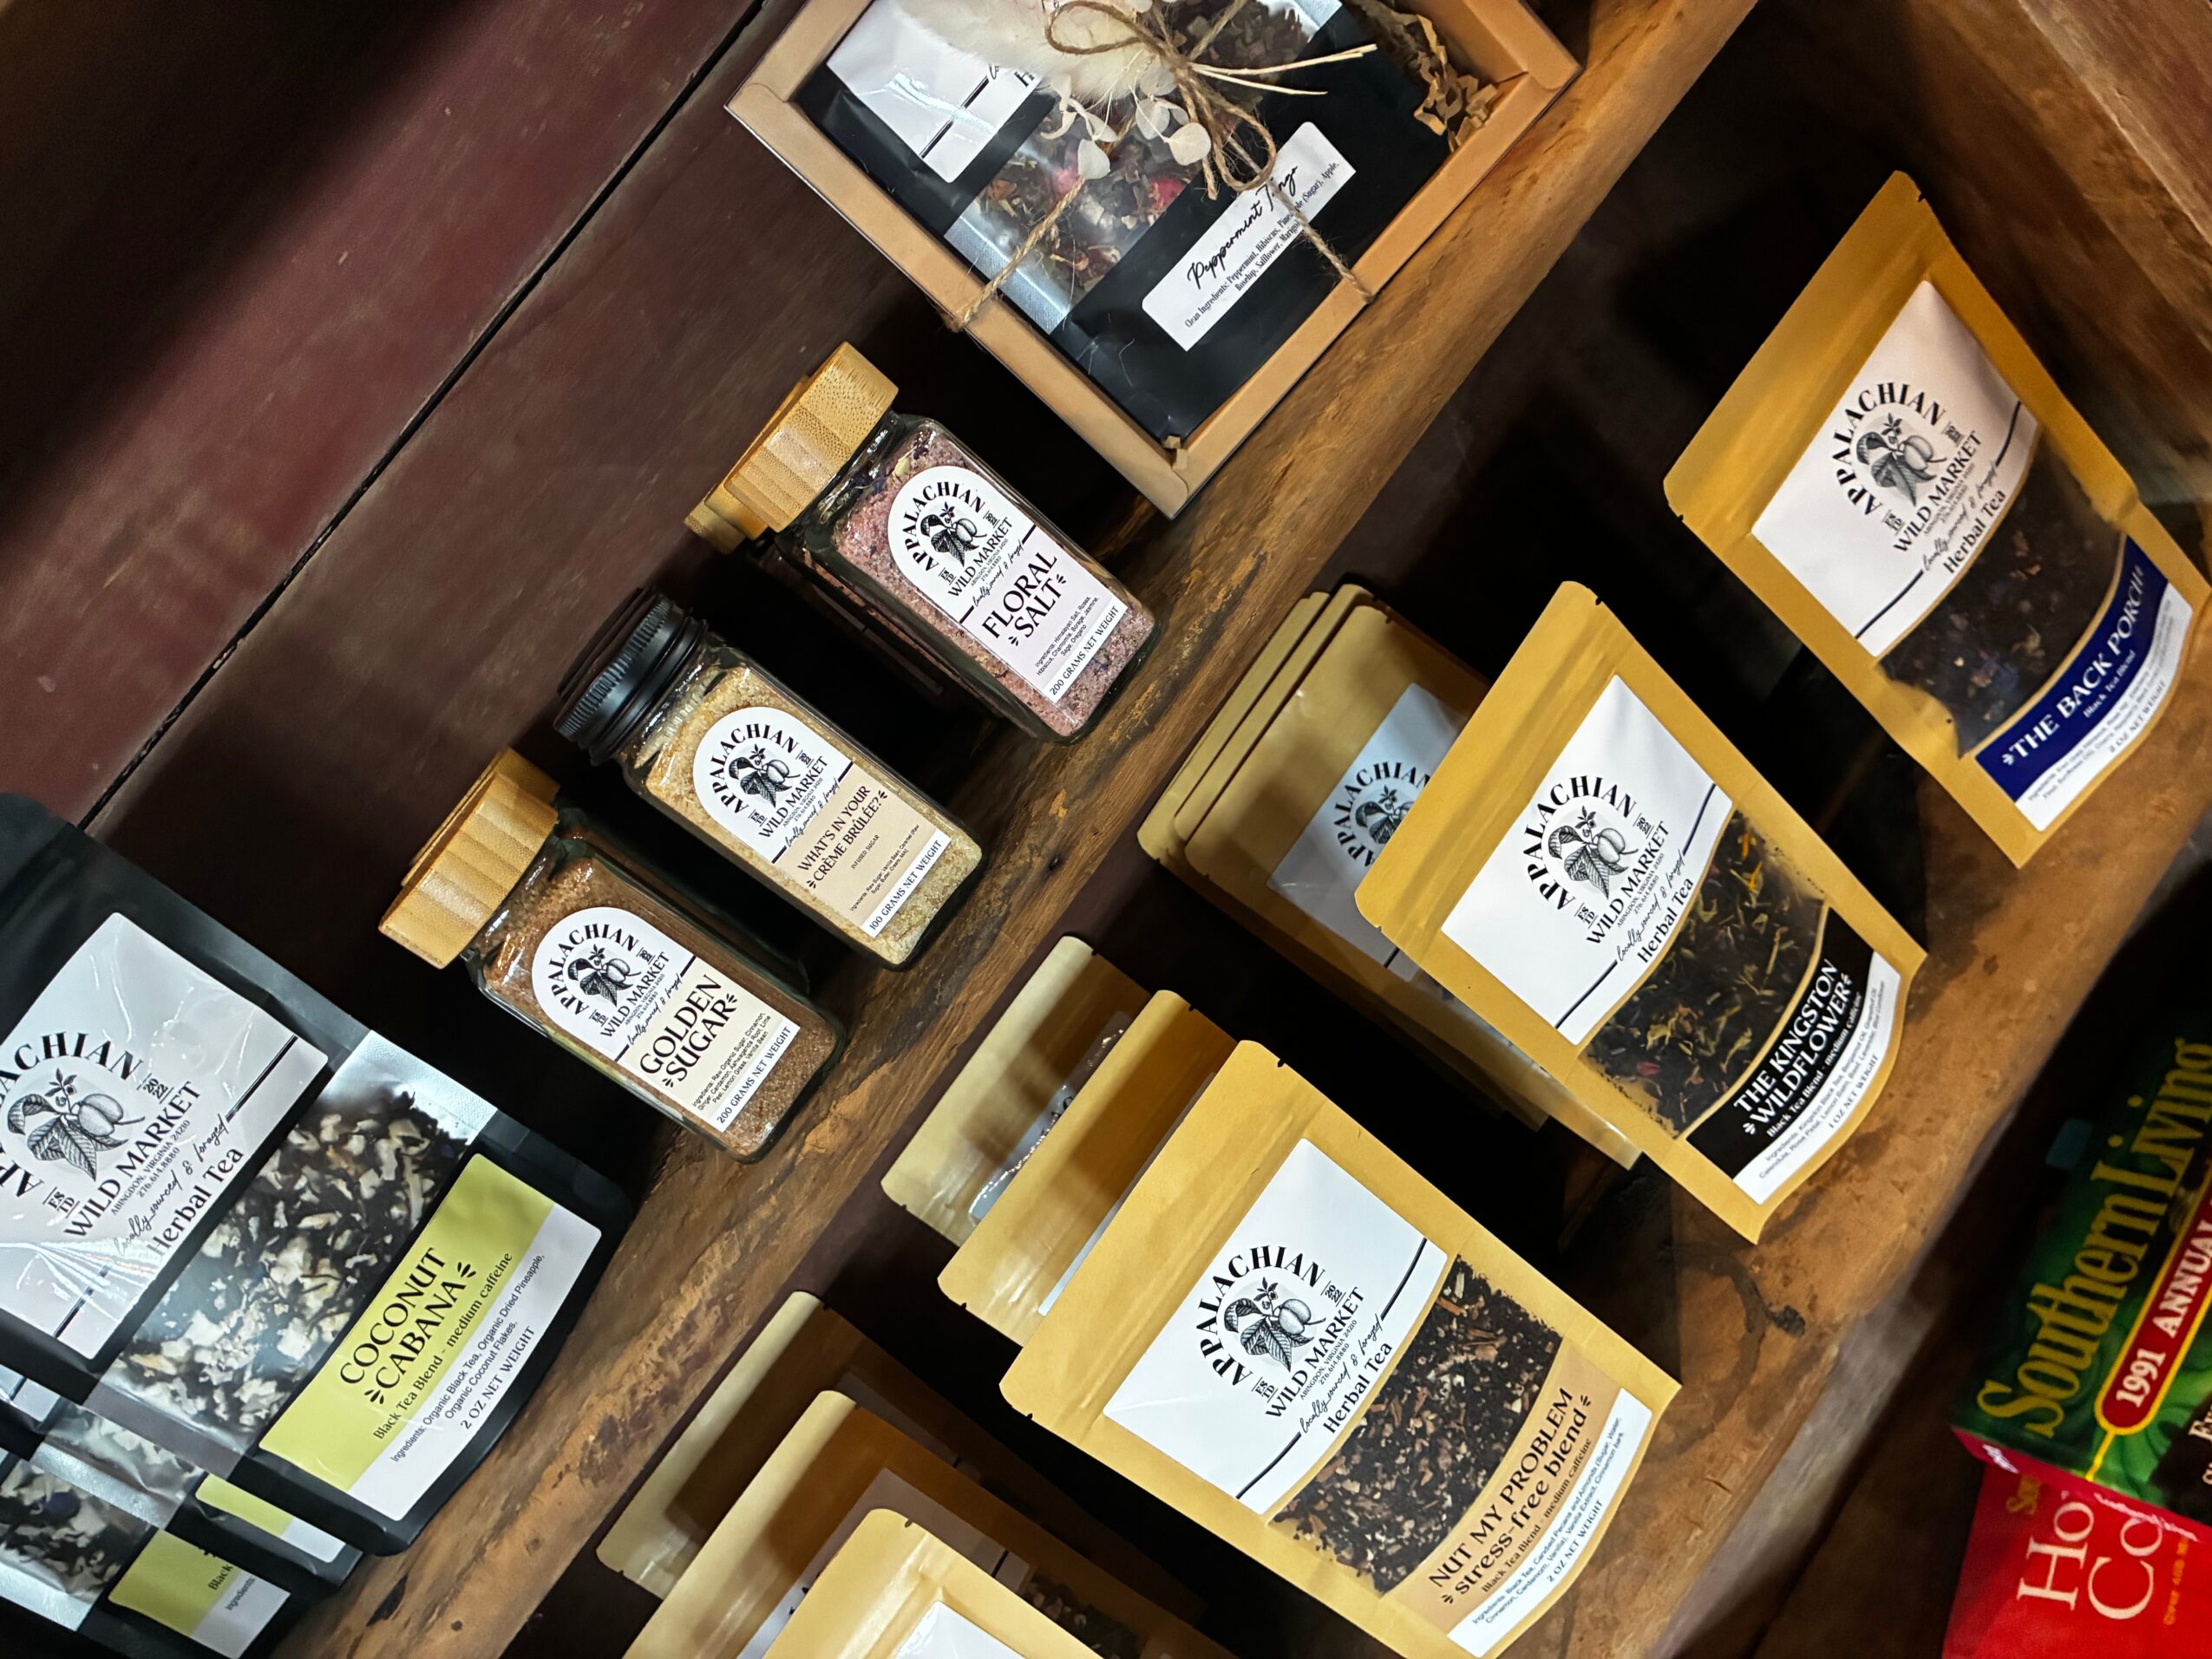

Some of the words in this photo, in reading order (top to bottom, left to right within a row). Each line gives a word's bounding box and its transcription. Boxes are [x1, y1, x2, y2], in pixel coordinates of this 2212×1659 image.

[1187, 199, 1263, 291] Peppermint
[1254, 166, 1299, 212] Tngo
[1254, 242, 1283, 269] Safflower,
[1279, 219, 1305, 242] Marigol
[1184, 312, 1201, 328] Clean
[1197, 281, 1230, 315] Ingredients:
[1226, 251, 1260, 284] Peppermint,
[1255, 228, 1281, 252] Hibiscus,
[1832, 382, 1946, 515] APPALACHIAN
[1893, 506, 1932, 552] WILD
[1927, 430, 1981, 506] MARKET
[902, 481, 985, 572] APPALACHIAN
[947, 565, 976, 597] WILD
[972, 516, 1012, 568] MARKET
[1942, 517, 1986, 574] Herbal
[1980, 490, 2006, 518] Tea
[981, 552, 1057, 639] FLORAL
[1014, 578, 1062, 638] SALT
[1049, 679, 1064, 696] 200
[1062, 650, 1086, 679] GRAMS
[1083, 635, 1097, 653] NET
[1095, 605, 1119, 636] WEIGHT
[2008, 714, 2059, 757] THE
[2056, 653, 2112, 718] BACK
[2106, 572, 2143, 656] PORCH
[2083, 694, 2107, 718] Black
[709, 723, 799, 813] APPALACHIAN
[758, 807, 789, 838] WILD
[785, 755, 828, 808] MARKET
[831, 816, 847, 833] IN
[841, 786, 871, 817] YOUR
[813, 842, 847, 881] CRÈME
[841, 796, 882, 846] BRÛLÉE?
[850, 850, 867, 870] INFUSED
[865, 834, 880, 852] SUGAR
[869, 916, 883, 931] 100
[881, 887, 906, 916] GRAMS
[902, 871, 918, 889] NET
[915, 839, 942, 871] WEIGHT
[1522, 775, 1637, 910] APPALACHIAN
[1586, 898, 1624, 944] WILD
[1620, 820, 1669, 898] MARKET
[1637, 906, 1678, 963] Herbal
[1671, 878, 1699, 905] Tea
[548, 923, 639, 1016] APPALACHIAN
[599, 1005, 631, 1037] WILD
[625, 951, 670, 1006] MARKET
[639, 974, 722, 1074] GOLDEN
[665, 999, 736, 1082] SUGAR
[759, 1015, 771, 1029] Lime
[1733, 1069, 1777, 1112] THE
[1769, 958, 1837, 1073] KINGSTON
[1750, 982, 1850, 1123] WILDFLOWER
[692, 1081, 714, 1108] Ingredients:
[711, 1069, 723, 1081] Raw
[720, 1048, 736, 1071] Organic
[717, 1107, 733, 1124] 200
[730, 1077, 756, 1107] GRAMS
[751, 1059, 768, 1078] NET
[764, 1026, 791, 1059] WEIGHT
[1766, 1114, 1791, 1138] Black
[1789, 1097, 1806, 1113] Tea
[1802, 1069, 1824, 1098] Blend
[63, 1179, 121, 1237] WILD
[115, 1081, 200, 1179] MARKET
[110, 1175, 145, 1216] ABINGDON,
[142, 1141, 173, 1172] VIRGINIA
[170, 1120, 191, 1141] 24210
[138, 1146, 180, 1198] 276.614.8880
[147, 1185, 213, 1251] Herbal
[202, 1148, 245, 1183] Tea
[149, 1169, 183, 1216] sourced
[193, 1113, 230, 1163] foraged
[1976, 1192, 2169, 1439] Southern
[2091, 1037, 2212, 1199] Living
[340, 1247, 446, 1384] COCONUT
[372, 1412, 402, 1440] Black
[396, 1391, 418, 1411] Tea
[412, 1355, 443, 1391] Blend
[446, 1300, 483, 1348] medium
[480, 1252, 513, 1298] caffeine
[376, 1281, 467, 1389] CABANA
[389, 1427, 427, 1462] Ingredients:
[422, 1394, 451, 1426] Organic
[446, 1370, 468, 1394] Black
[462, 1353, 483, 1369] Tea,
[477, 1316, 504, 1350] Organic
[499, 1293, 519, 1318] Dried
[514, 1255, 546, 1295] Pineapple,
[1195, 1245, 1325, 1386] APPALACHIAN
[1265, 1369, 1308, 1417] WILD
[1304, 1286, 1365, 1369] MARKET
[444, 1386, 473, 1420] Organic
[468, 1349, 498, 1386] Coconut
[493, 1322, 518, 1351] Flakes.
[460, 1420, 472, 1430] 2
[468, 1399, 487, 1419] OZ
[481, 1374, 503, 1400] NET
[499, 1325, 534, 1372] WEIGHT
[1299, 1398, 1332, 1434] locally
[1327, 1361, 1351, 1401] sourced
[1358, 1313, 1384, 1356] foraged
[1323, 1374, 1371, 1434] Herbal
[1364, 1342, 1393, 1372] Tea
[2116, 1348, 2167, 1408] 1991
[1428, 1542, 1472, 1588] NUT
[1469, 1504, 1502, 1545] MY
[1499, 1388, 1573, 1506] PROBLEM
[1455, 1479, 1549, 1595] stress-free
[1543, 1408, 1587, 1478] blend
[1481, 1561, 1513, 1593] Black
[1509, 1552, 1522, 1564] Tea
[1517, 1524, 1541, 1552] Blend
[1543, 1479, 1570, 1519] medium
[1568, 1438, 1592, 1478] caffeine
[207, 1564, 233, 1590] Black
[1554, 1559, 1566, 1575] OZ
[1564, 1540, 1580, 1558] NET
[1577, 1499, 1603, 1538] WEIGHT
